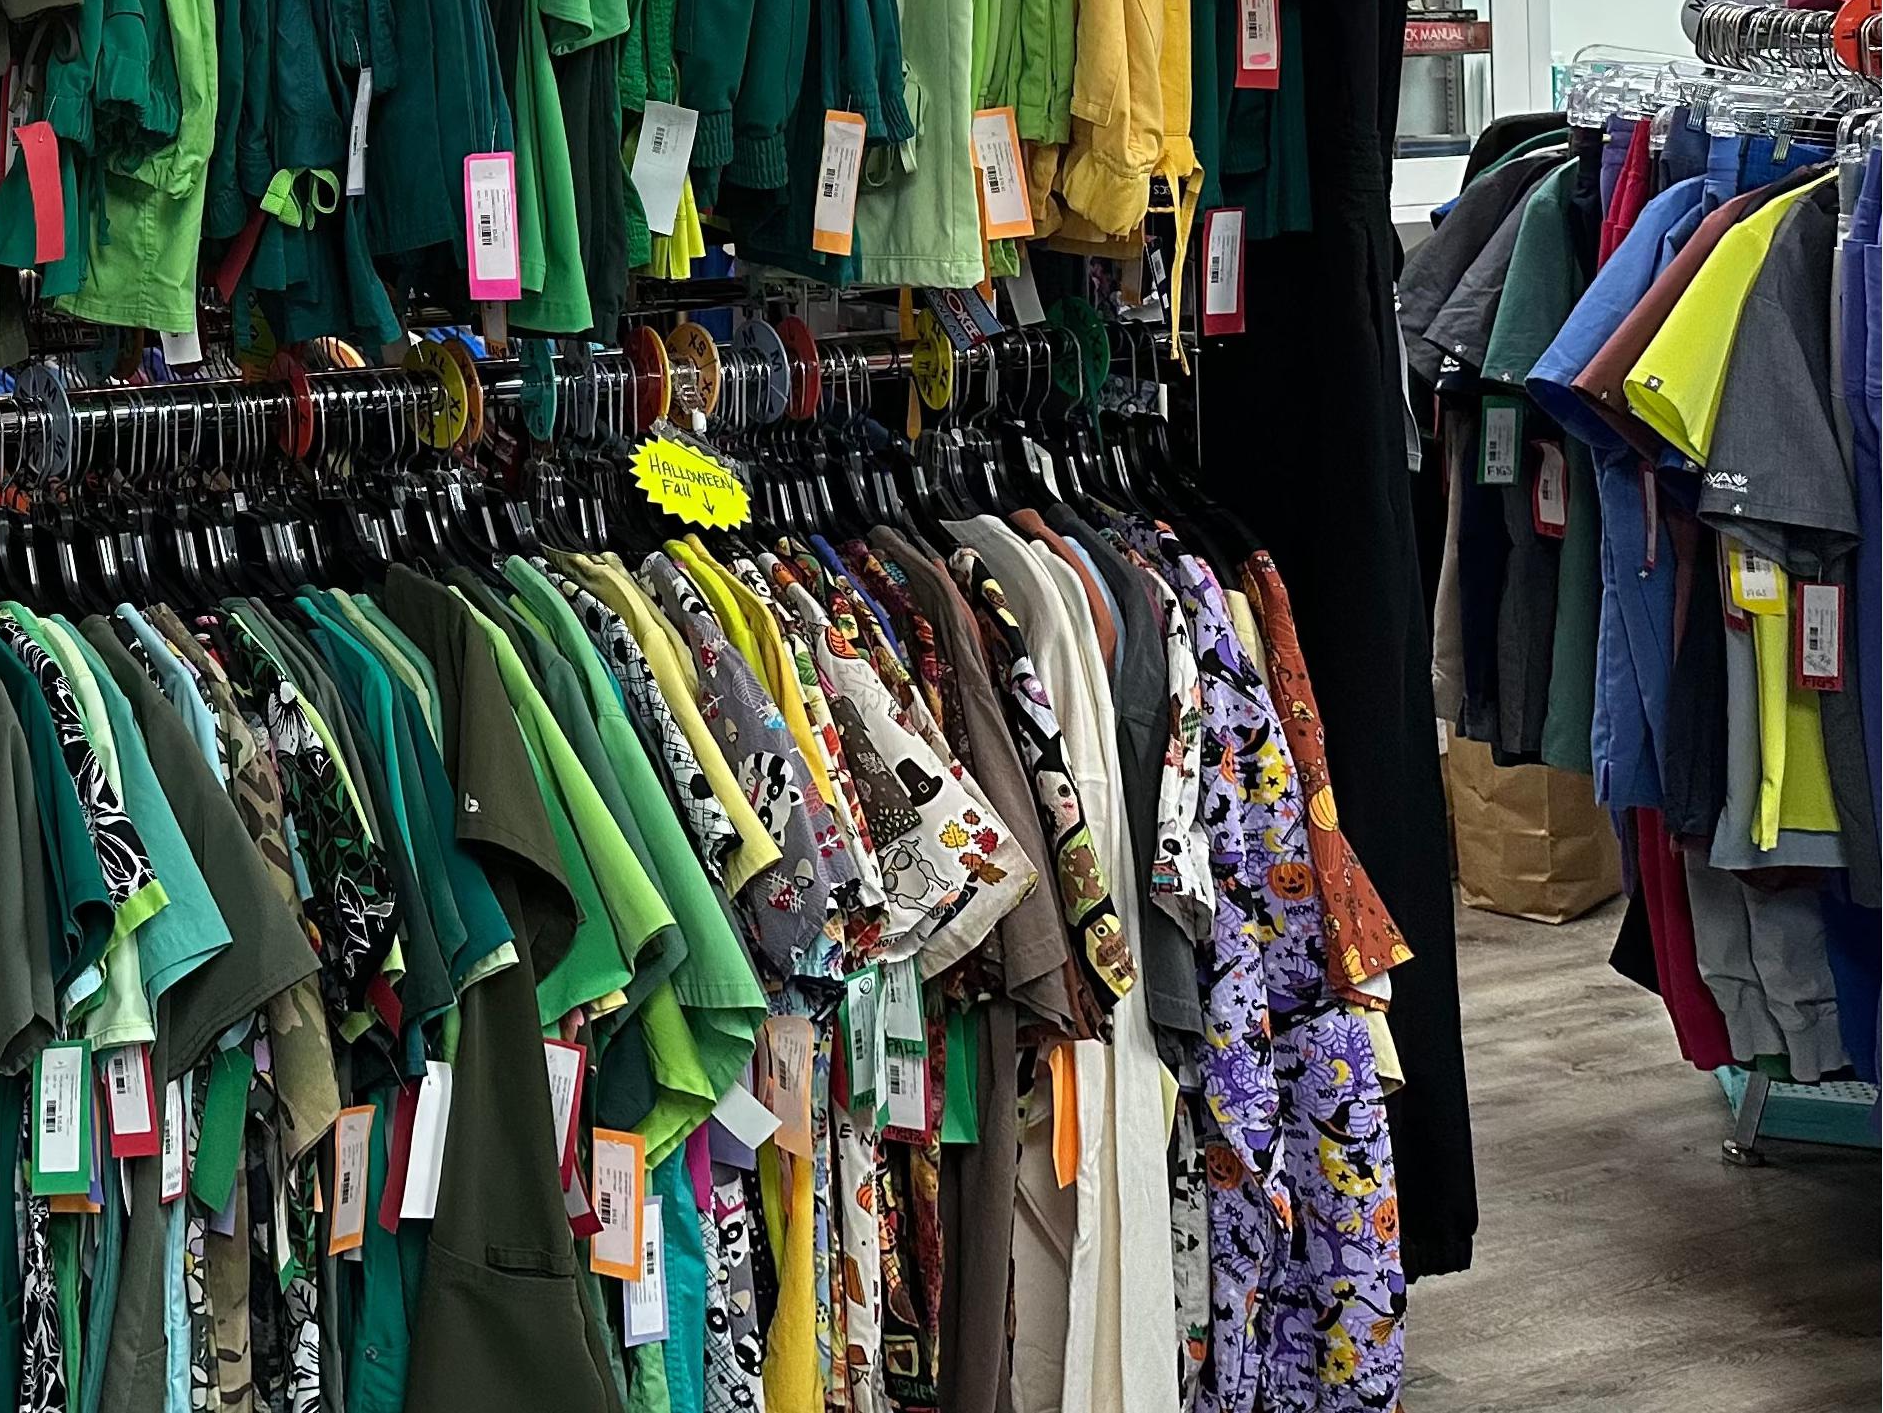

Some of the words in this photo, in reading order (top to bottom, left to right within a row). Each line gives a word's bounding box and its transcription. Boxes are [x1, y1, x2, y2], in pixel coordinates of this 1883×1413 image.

[1420, 28, 1464, 41] MANUAL
[689, 332, 706, 357] XS
[429, 350, 446, 375] XL
[649, 453, 734, 496] HALLOWEEN
[1284, 903, 1315, 916] MEOW
[1213, 1020, 1233, 1035] BOO
[1273, 1043, 1300, 1055] MEOW
[1318, 1088, 1339, 1100] BOO
[1370, 1364, 1397, 1378] MEOW
